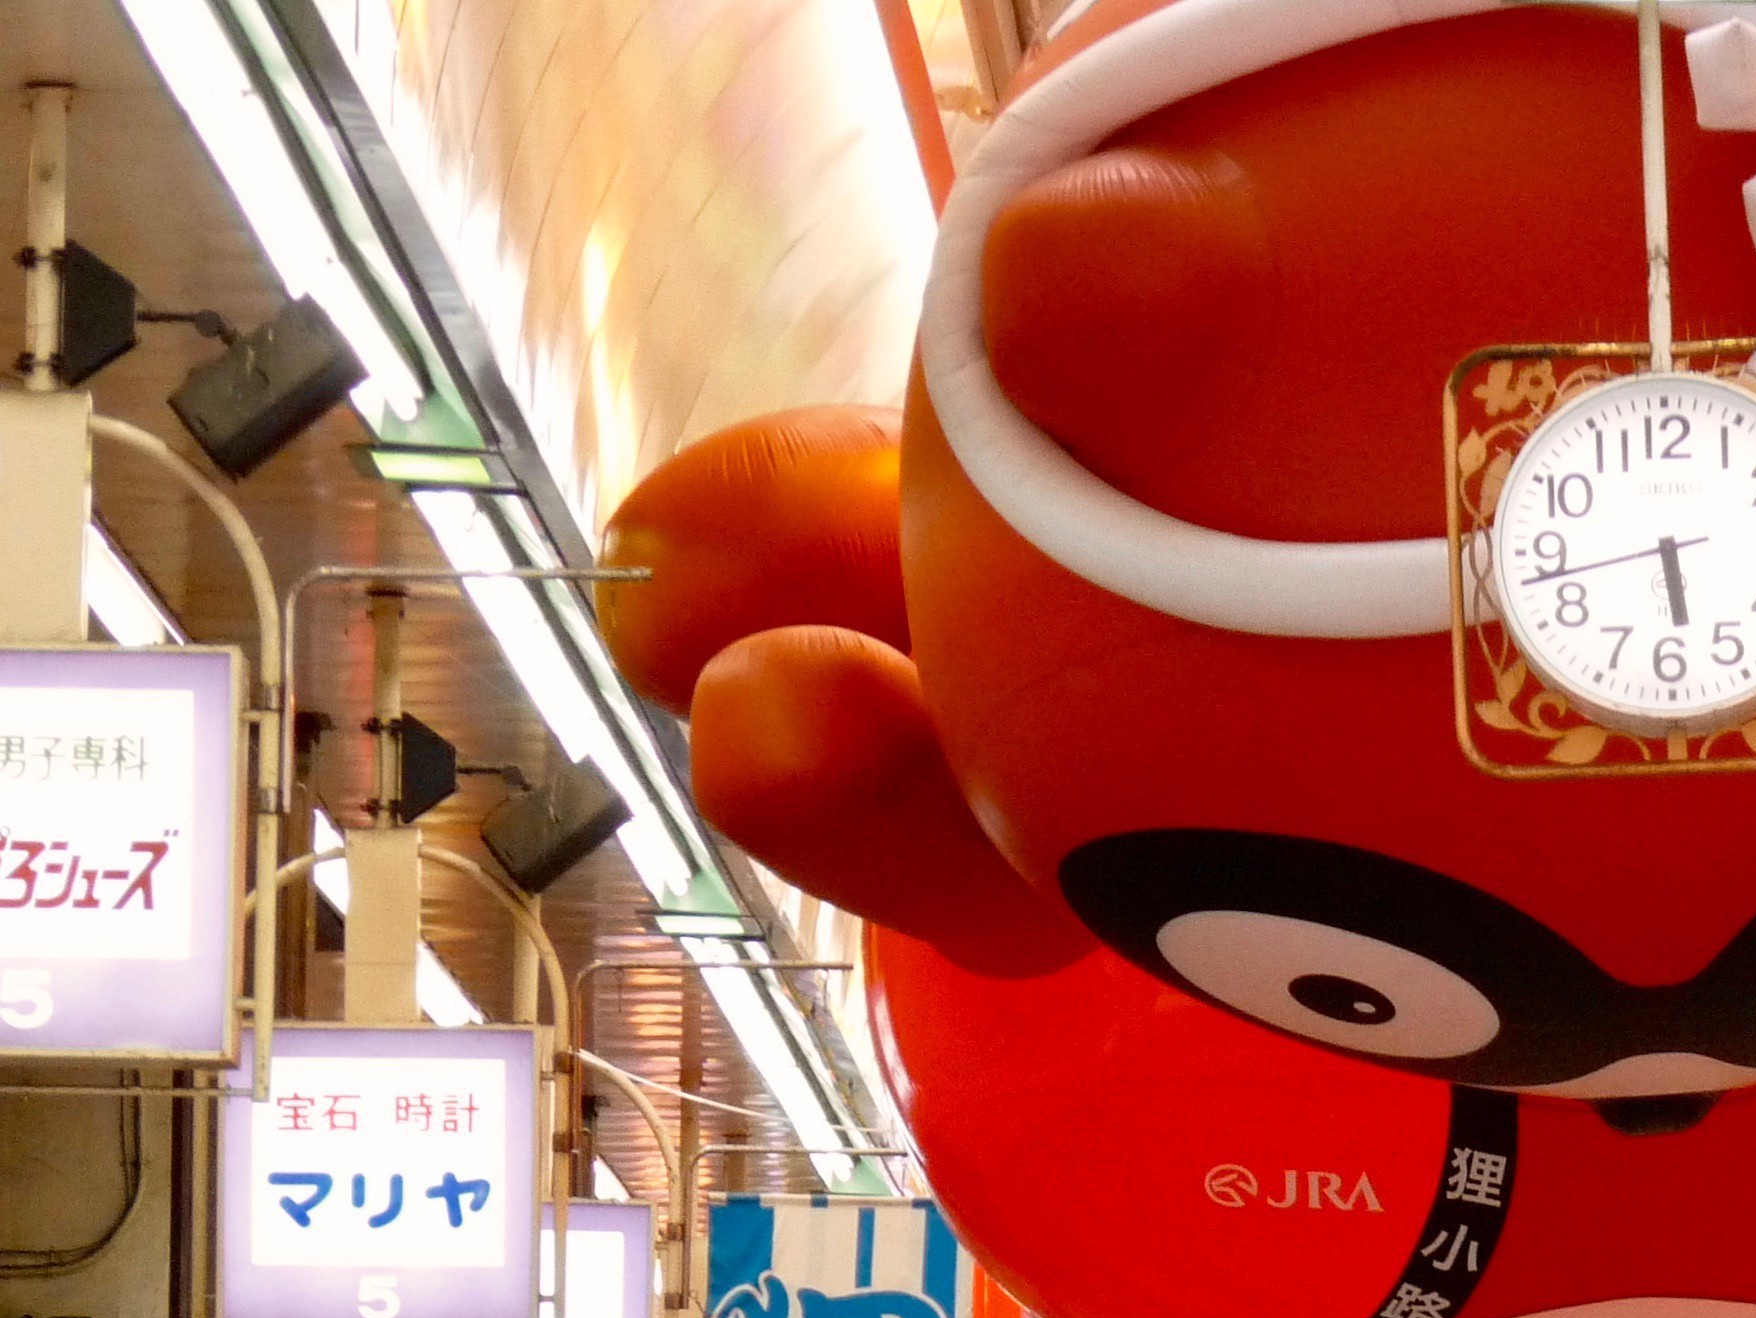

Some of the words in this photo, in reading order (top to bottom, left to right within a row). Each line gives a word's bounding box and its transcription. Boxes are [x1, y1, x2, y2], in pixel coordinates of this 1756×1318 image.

[1596, 428, 1629, 474] 11
[1644, 415, 1692, 460] 12
[1721, 425, 1731, 470] 1
[1547, 472, 1593, 518] 10
[1532, 530, 1567, 577] 9
[1554, 582, 1589, 627] 8
[1600, 626, 1634, 670] 7
[1652, 636, 1687, 683] 6
[1711, 621, 1745, 666] 5
[0, 735, 149, 781] 男子専科
[0, 968, 53, 1030] 5
[276, 1095, 359, 1132] 宝石
[394, 1094, 481, 1132] 時計
[268, 1171, 491, 1228] マリヤ
[1266, 1169, 1386, 1213] JRA
